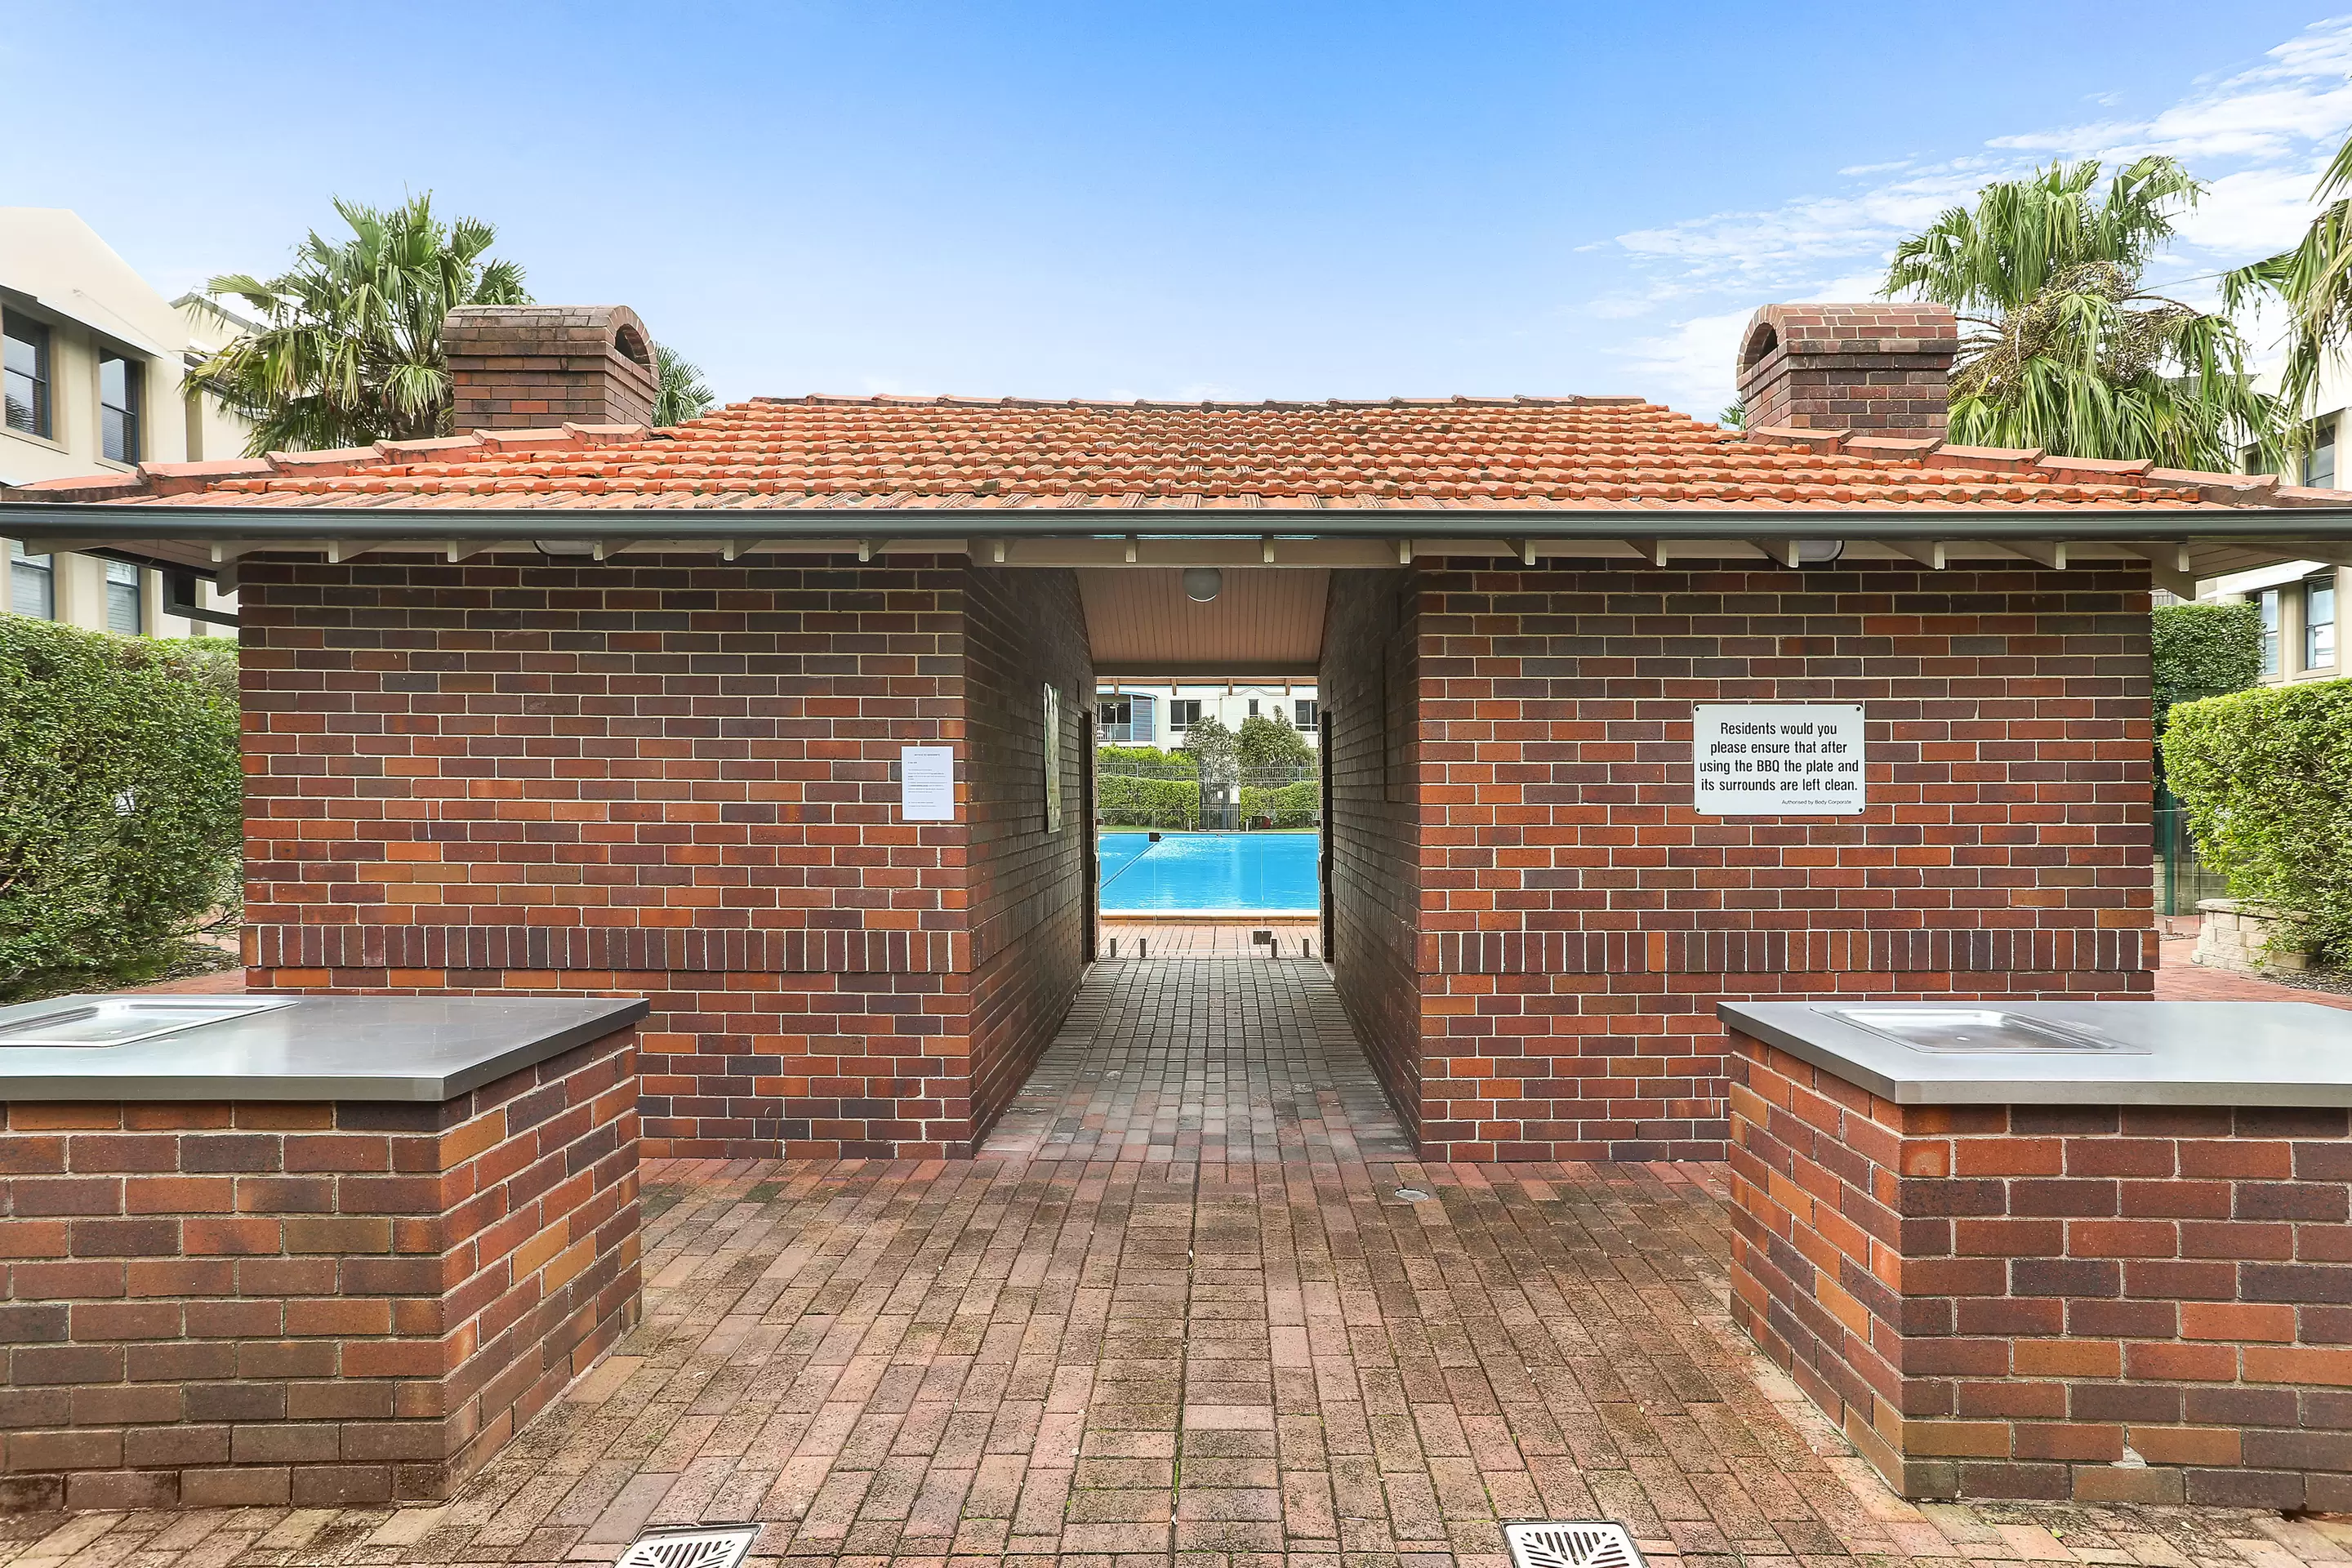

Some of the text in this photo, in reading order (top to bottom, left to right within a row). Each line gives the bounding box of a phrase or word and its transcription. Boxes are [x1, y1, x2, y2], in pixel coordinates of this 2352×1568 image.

[1720, 722, 1838, 737] Residents would you
[1710, 741, 1847, 756] please ensure that after
[1699, 760, 1859, 775] using the BBQ the plate and
[1701, 778, 1858, 791] its surrounds are left clean.
